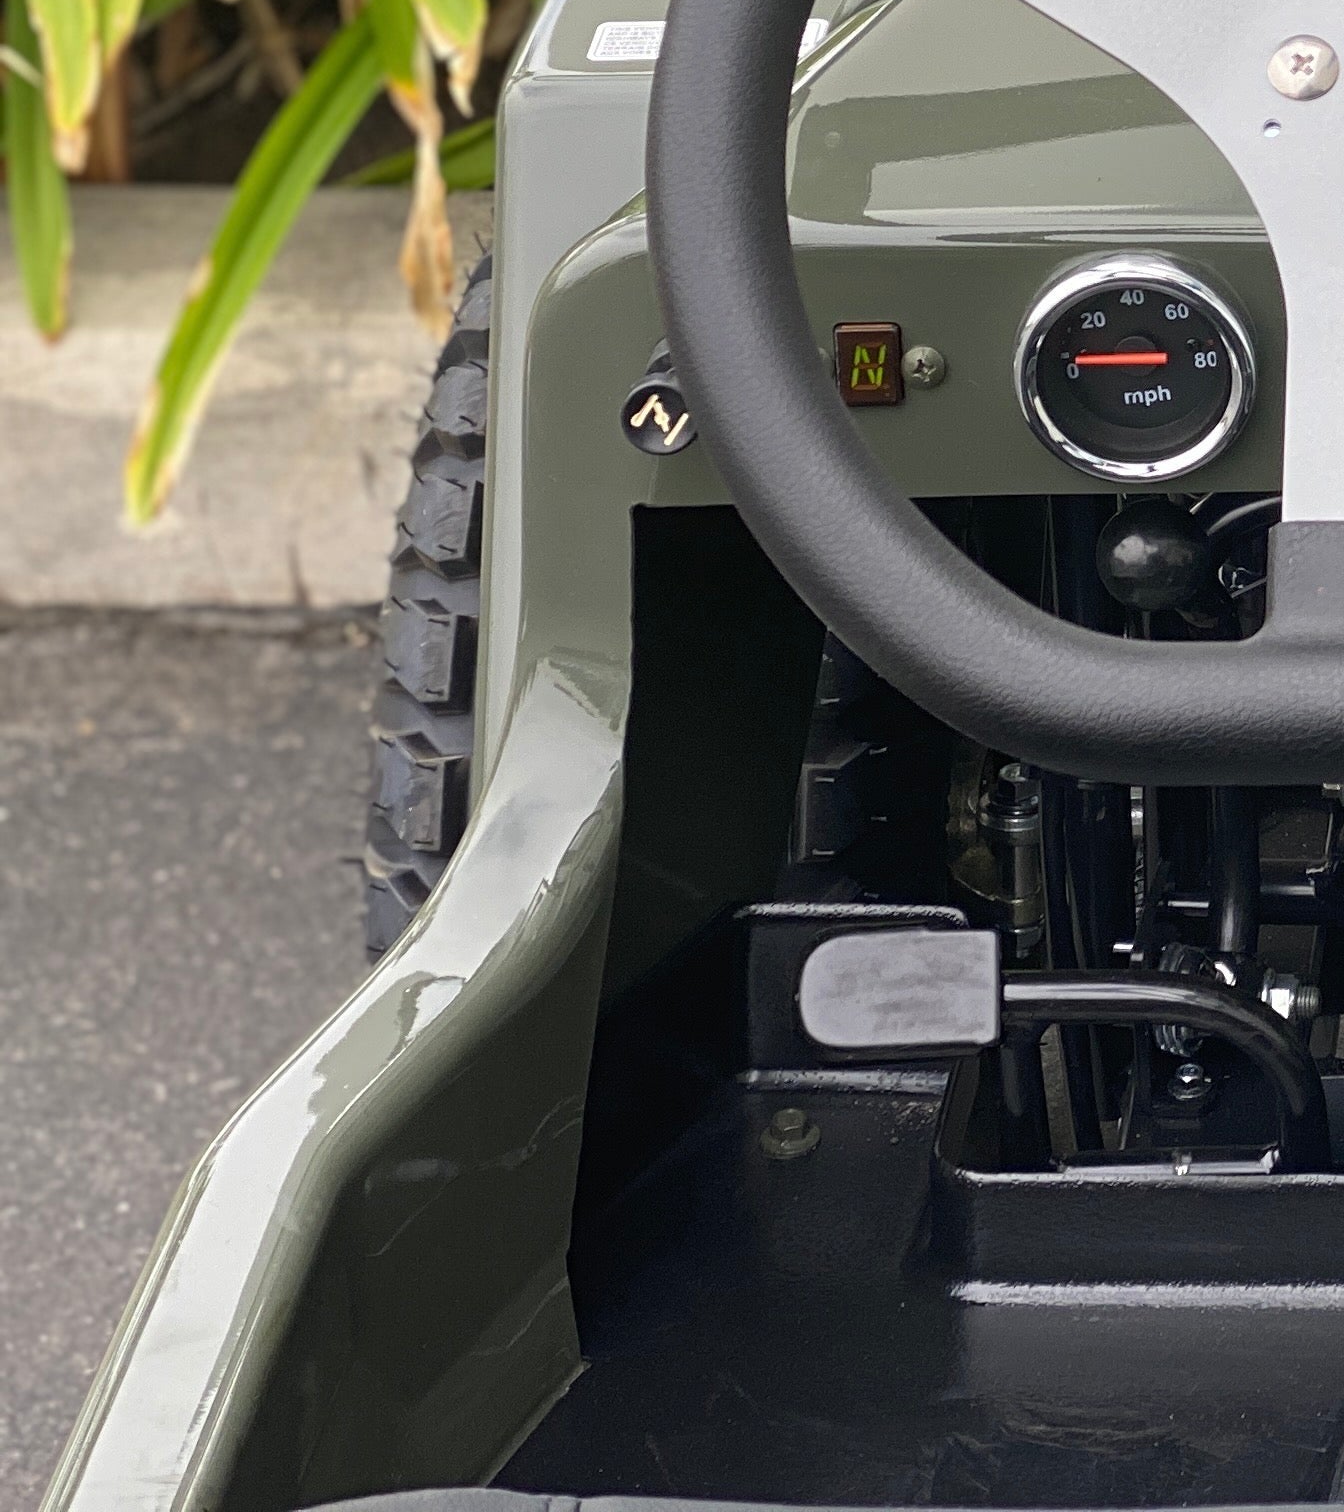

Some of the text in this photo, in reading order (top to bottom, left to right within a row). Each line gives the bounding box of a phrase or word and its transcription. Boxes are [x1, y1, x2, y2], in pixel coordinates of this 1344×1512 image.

[1120, 289, 1145, 306] 40
[1080, 311, 1106, 329] 20
[1164, 303, 1189, 320] 60
[1194, 351, 1217, 368] 80
[1066, 362, 1079, 379] 0
[1124, 385, 1172, 406] mph
